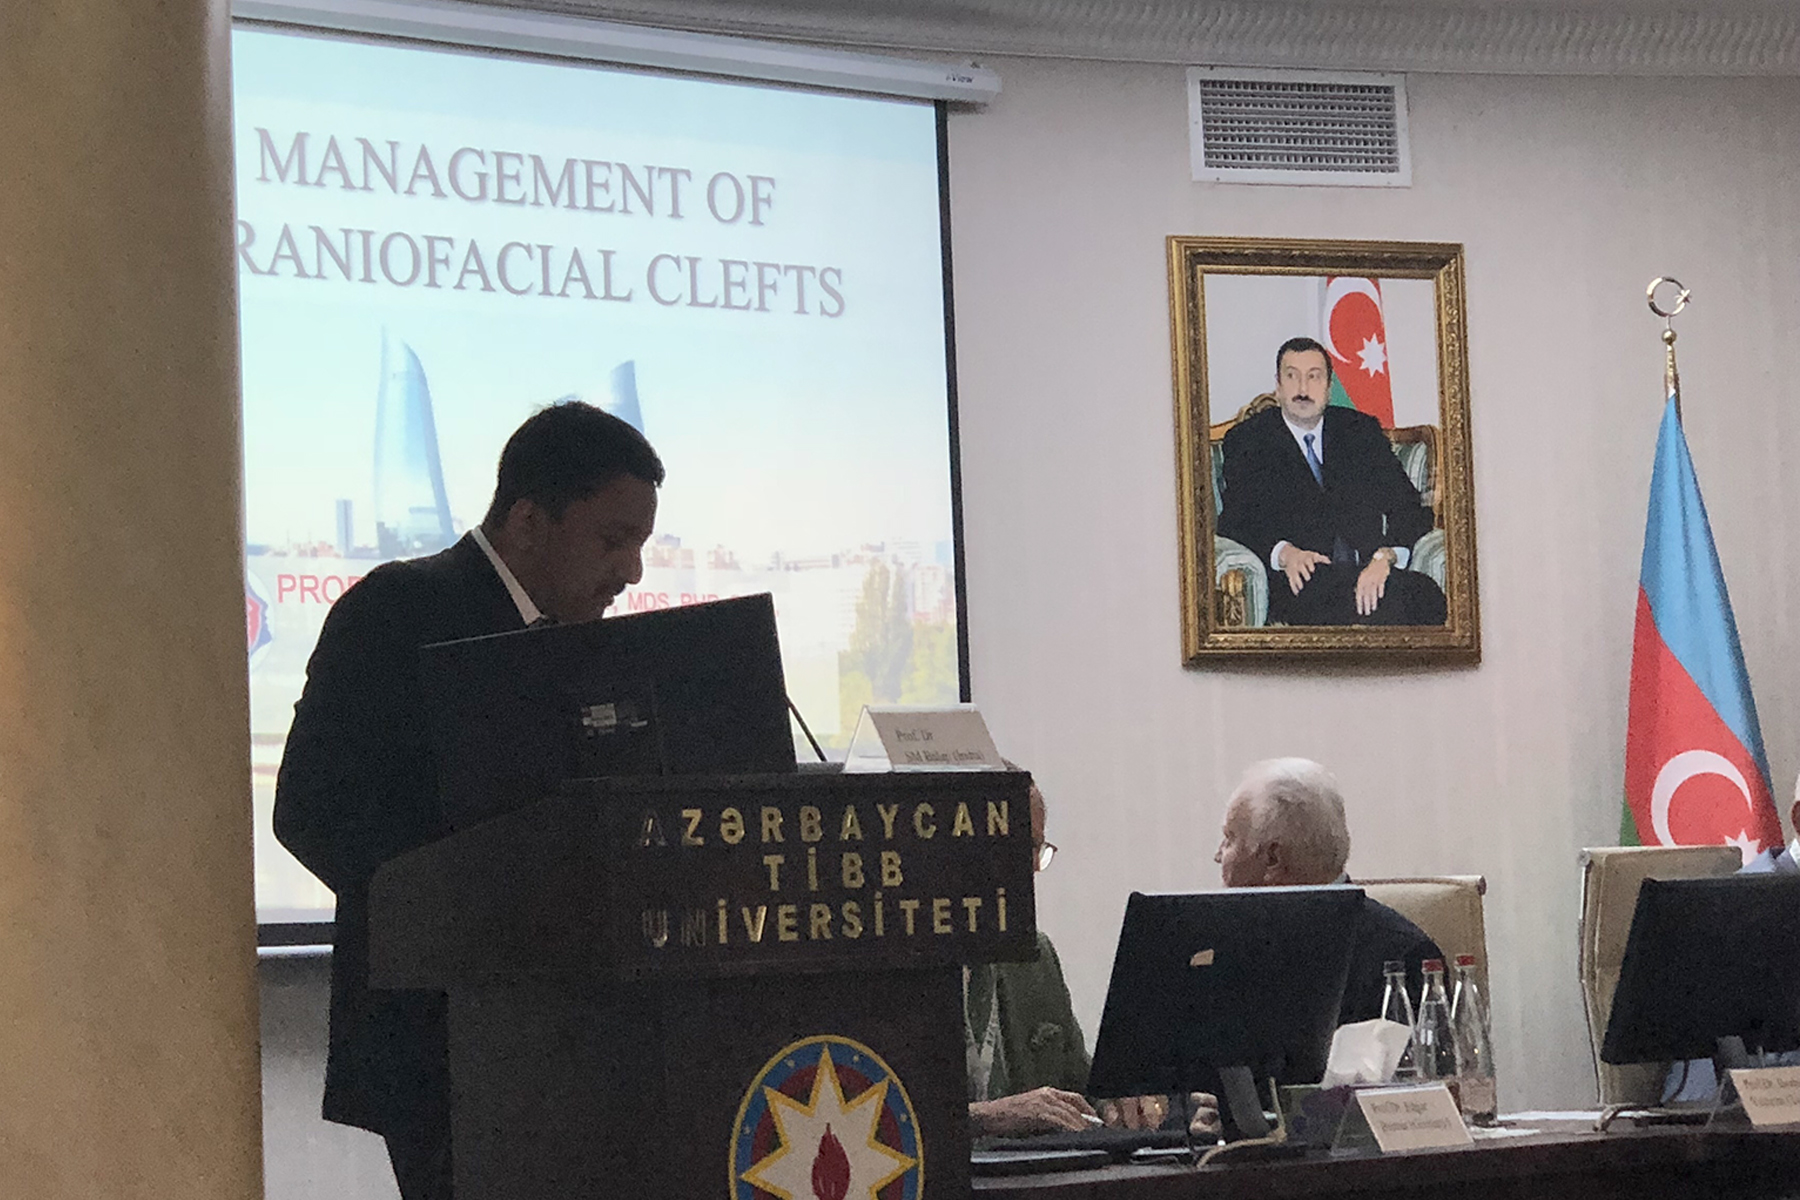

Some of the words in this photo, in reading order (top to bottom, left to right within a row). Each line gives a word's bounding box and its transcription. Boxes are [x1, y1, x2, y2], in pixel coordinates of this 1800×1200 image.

[254, 127, 692, 219] MANAGEMENT
[706, 171, 776, 226] OF
[647, 253, 847, 318] CLEFTS
[638, 800, 1010, 847] AZƏRBAYCAN
[763, 846, 904, 891] TİBB
